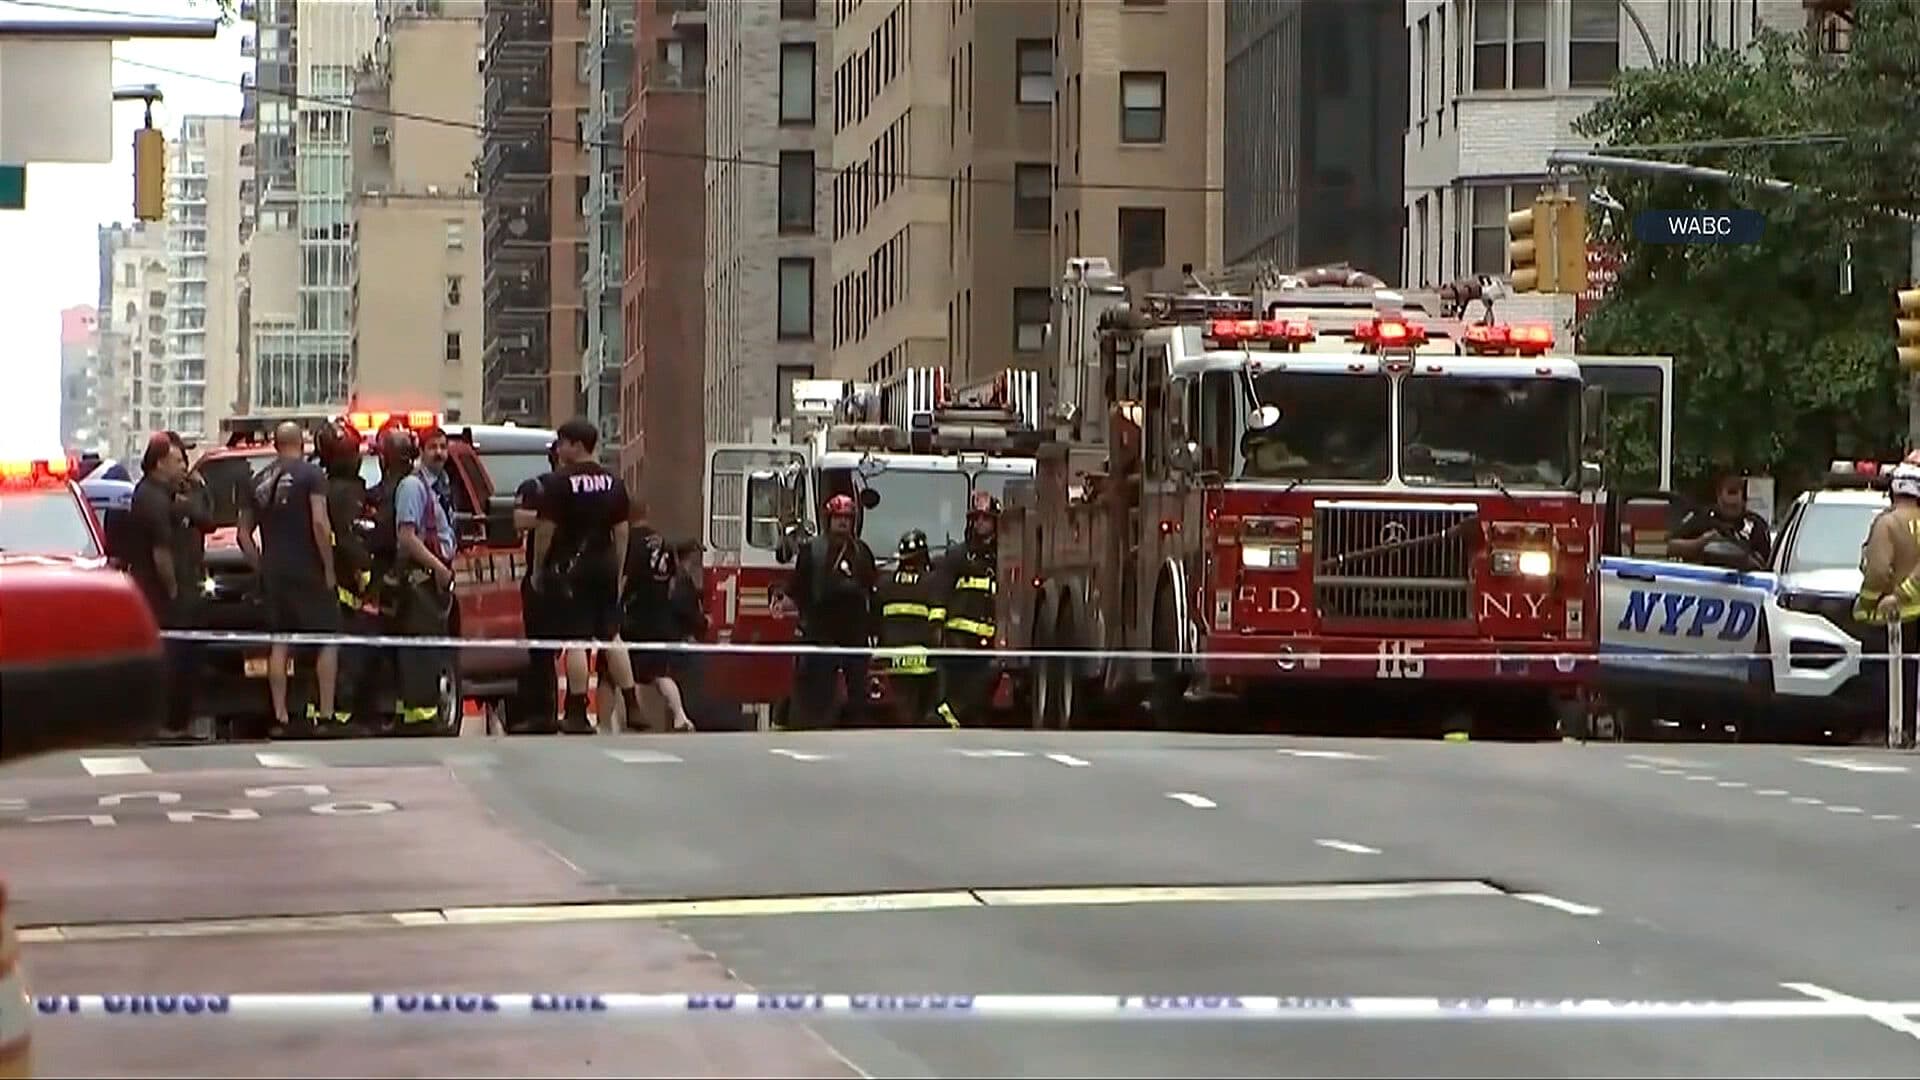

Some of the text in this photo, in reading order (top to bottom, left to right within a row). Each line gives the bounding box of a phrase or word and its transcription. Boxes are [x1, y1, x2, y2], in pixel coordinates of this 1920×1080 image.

[569, 474, 613, 493] FDNY
[716, 574, 737, 624] 1
[1480, 592, 1552, 619] N.Y.
[1618, 590, 1757, 642] NYPD
[1376, 639, 1425, 679] 115
